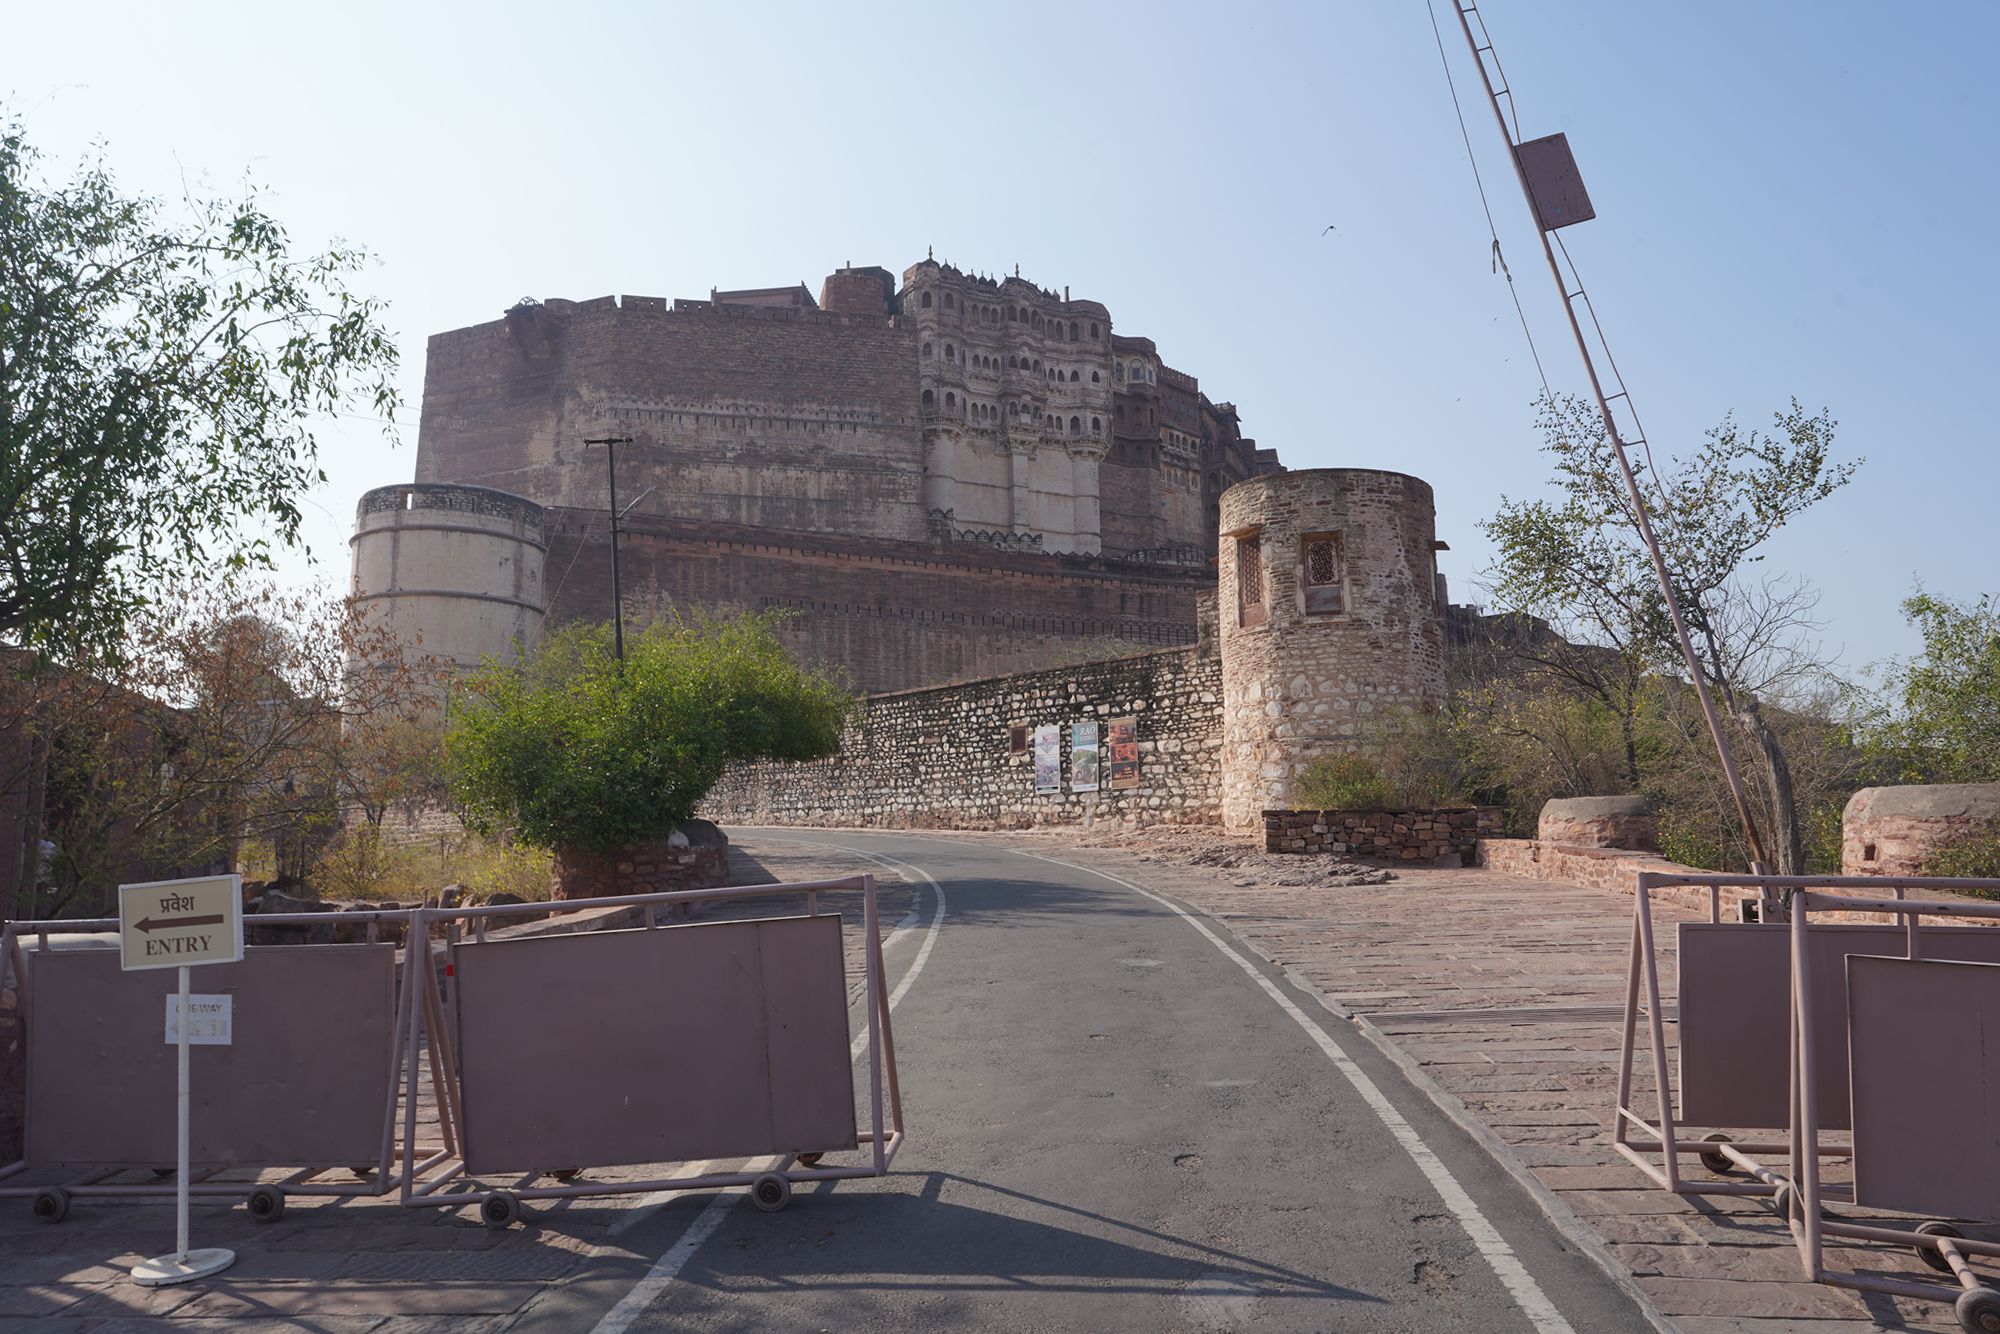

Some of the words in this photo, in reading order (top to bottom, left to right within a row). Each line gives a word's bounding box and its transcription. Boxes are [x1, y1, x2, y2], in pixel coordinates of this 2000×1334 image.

[1080, 726, 1096, 736] RAO
[160, 892, 195, 913] प्रवेश
[145, 935, 212, 956] ENTRY
